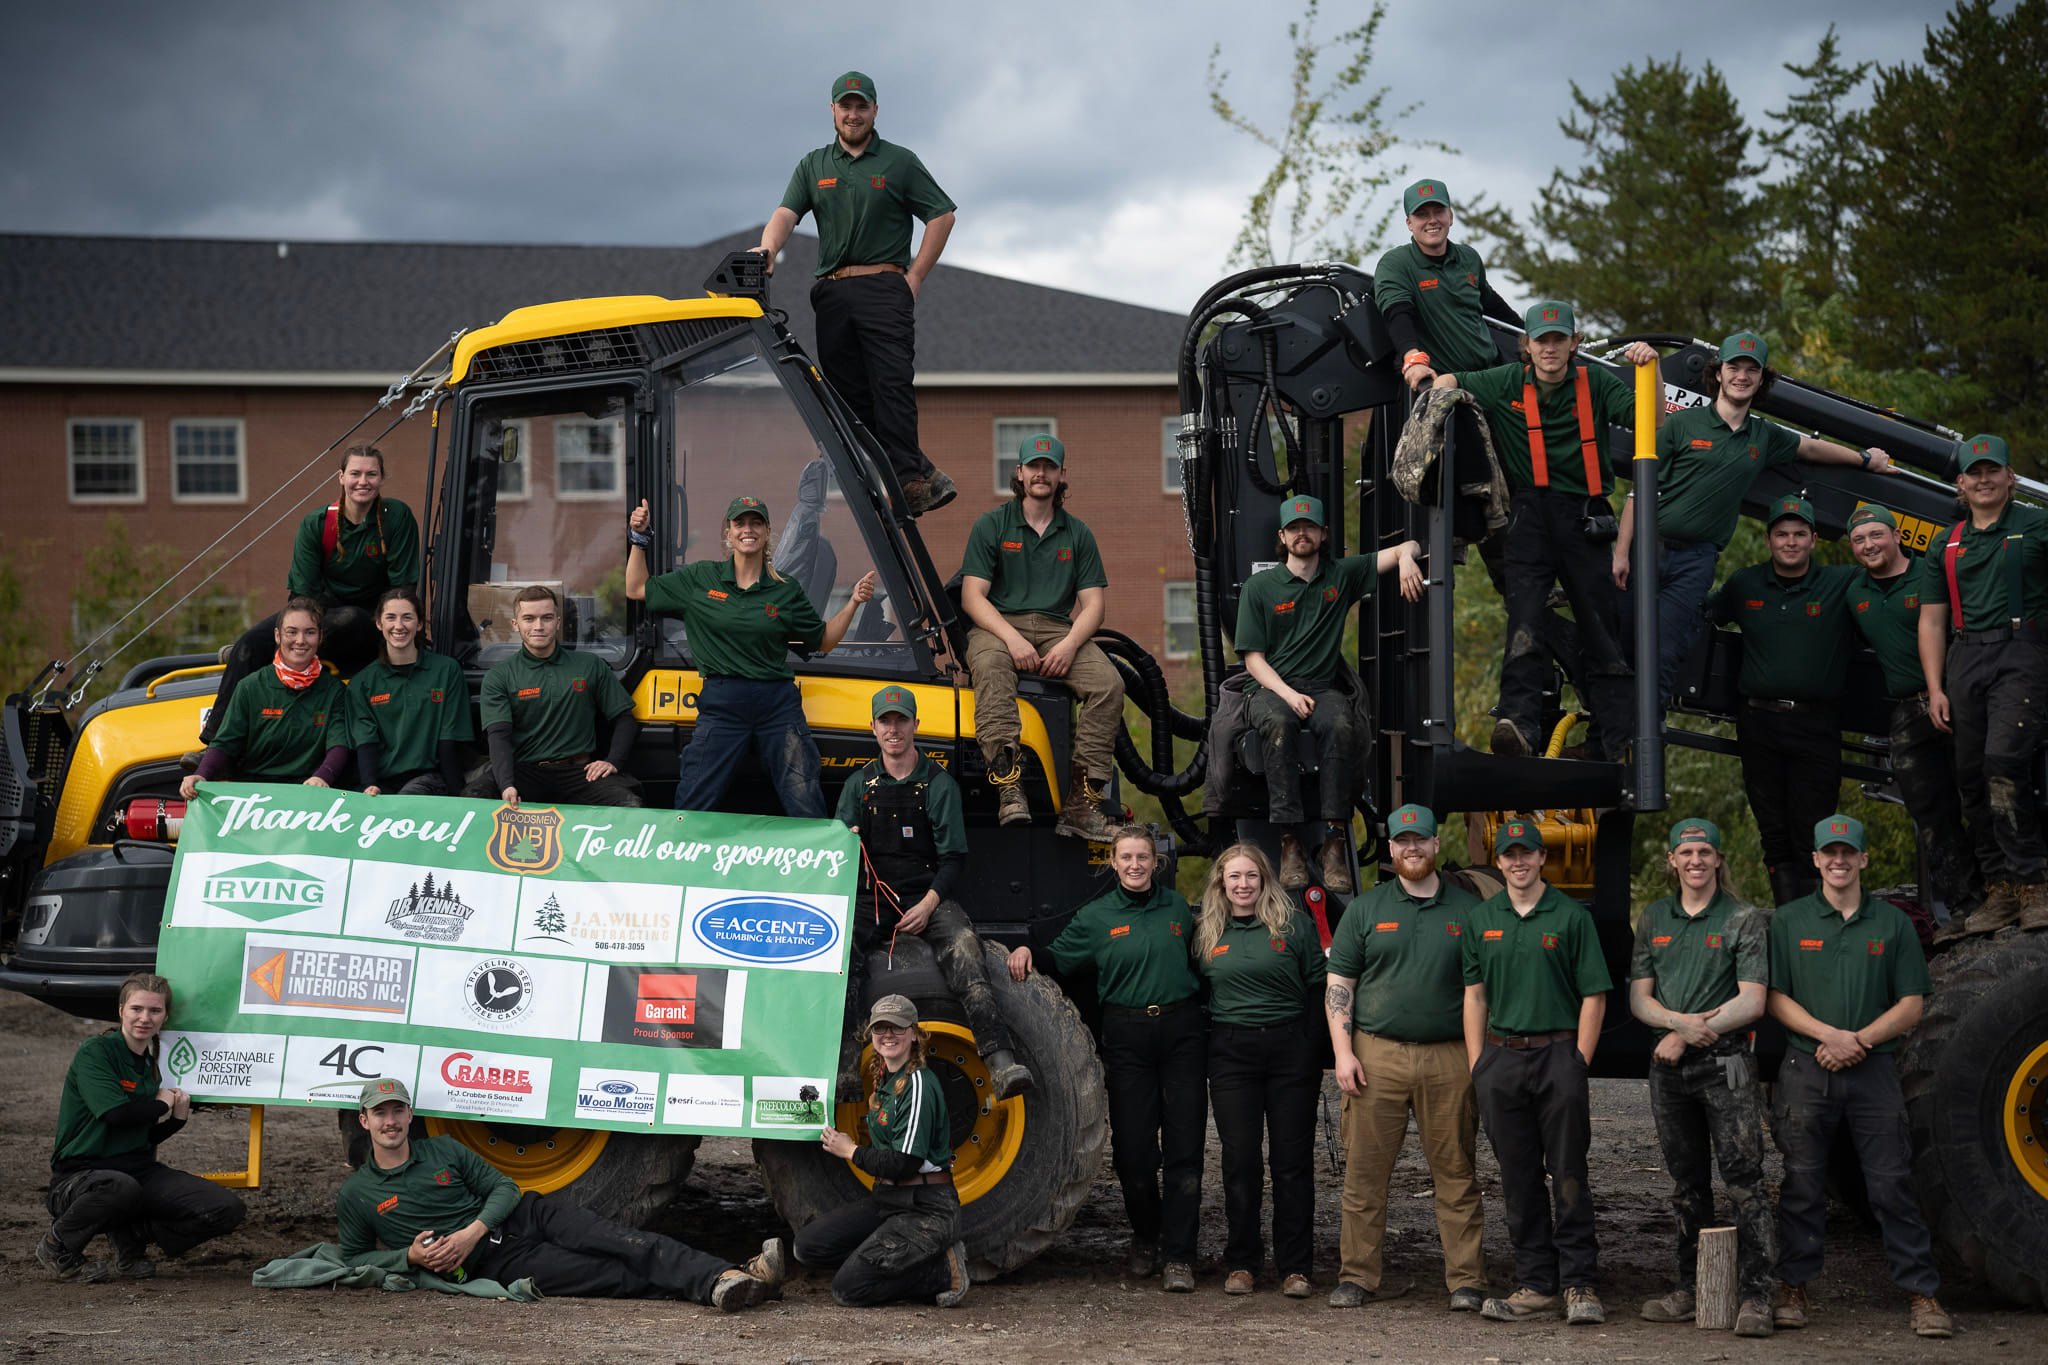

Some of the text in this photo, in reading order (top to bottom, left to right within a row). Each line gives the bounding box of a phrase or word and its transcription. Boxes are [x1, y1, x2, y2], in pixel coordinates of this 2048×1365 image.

[211, 793, 476, 852] Thank you!
[501, 812, 557, 825] WOODSMEN
[571, 823, 848, 877] To all our sponsors
[202, 880, 324, 904] IRVING
[414, 896, 474, 920] KENNEDY
[727, 917, 809, 936] ACCENT
[571, 928, 669, 942] CONTRACTING
[715, 931, 815, 946] PLUMBING & HEATING
[594, 941, 645, 952] 506-478-3055
[290, 951, 403, 983] FREE-BARR
[466, 959, 531, 994] TRAVELING SEED
[288, 976, 405, 1003] INTERIORS INC.
[471, 1001, 493, 1019] TREE
[497, 1005, 522, 1020] CARE
[645, 1003, 687, 1021] Garant
[633, 1027, 694, 1041] Proud Sponsor
[201, 1050, 275, 1064] SUSTAINABLE
[319, 1043, 385, 1079] 4C
[199, 1062, 252, 1075] FORESTRY
[441, 1052, 532, 1093] CRABBE
[197, 1074, 252, 1087] INITIATIVE
[607, 1083, 627, 1093] Ford
[462, 1091, 487, 1099] Crabbe
[677, 1096, 693, 1104] esri
[758, 1101, 807, 1111] TREECOLOGIC
